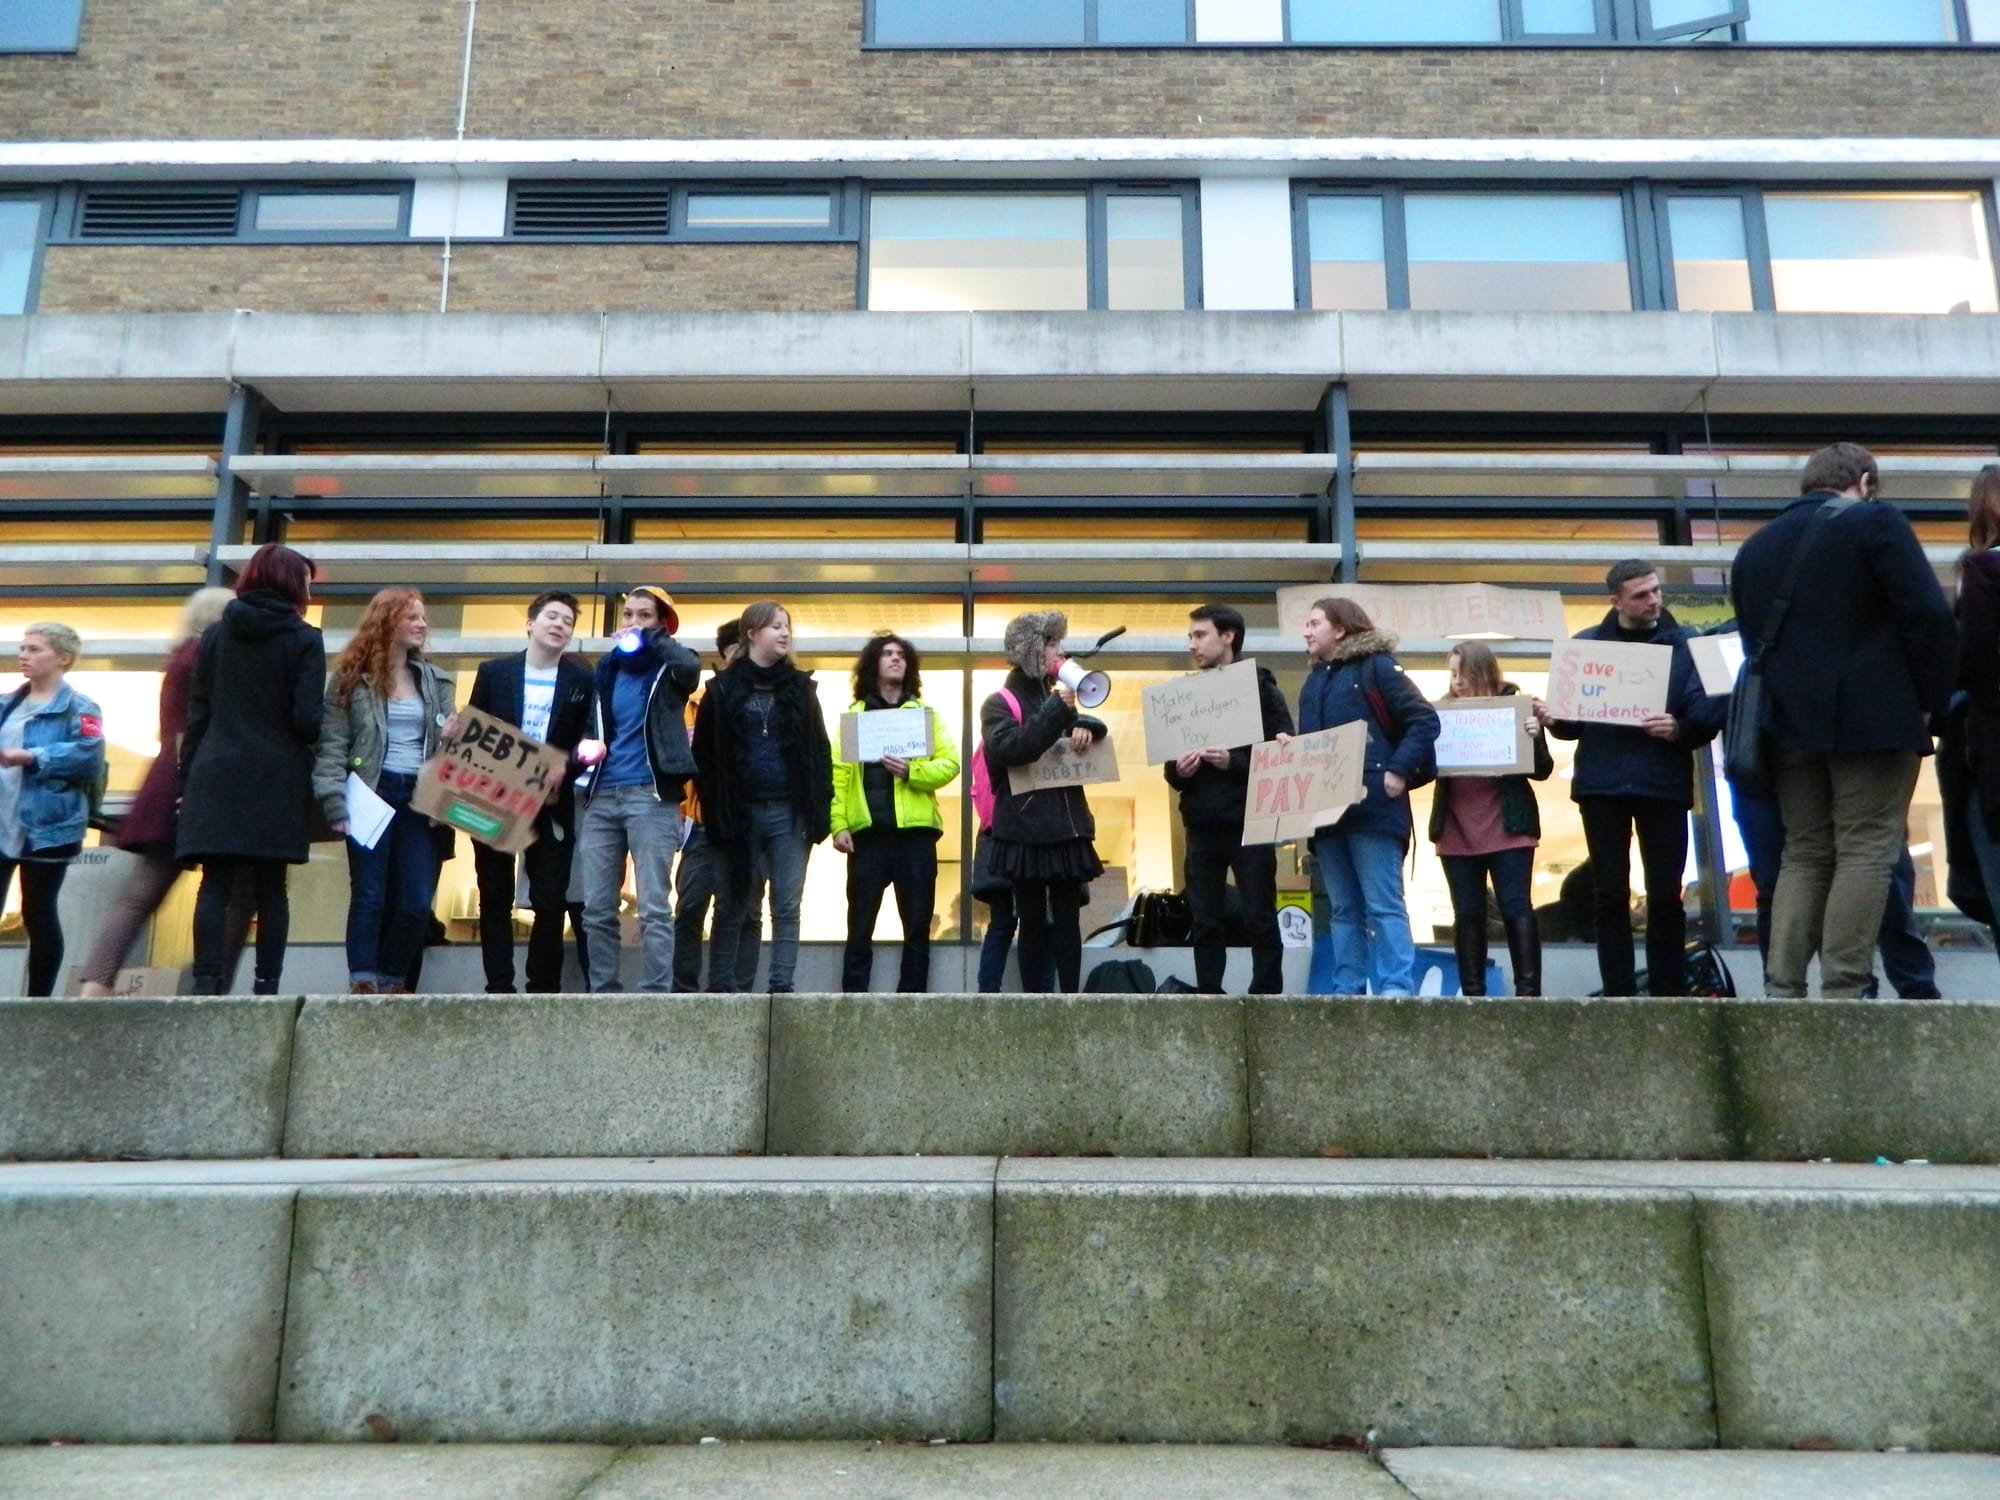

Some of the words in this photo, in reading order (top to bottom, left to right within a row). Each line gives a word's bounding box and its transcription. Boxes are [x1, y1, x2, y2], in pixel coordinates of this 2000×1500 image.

[1562, 649, 1615, 678] Save
[1151, 688, 1194, 714] Make
[1161, 711, 1183, 727] Tax
[461, 717, 540, 769] DEBT
[1255, 772, 1314, 814] PAY
